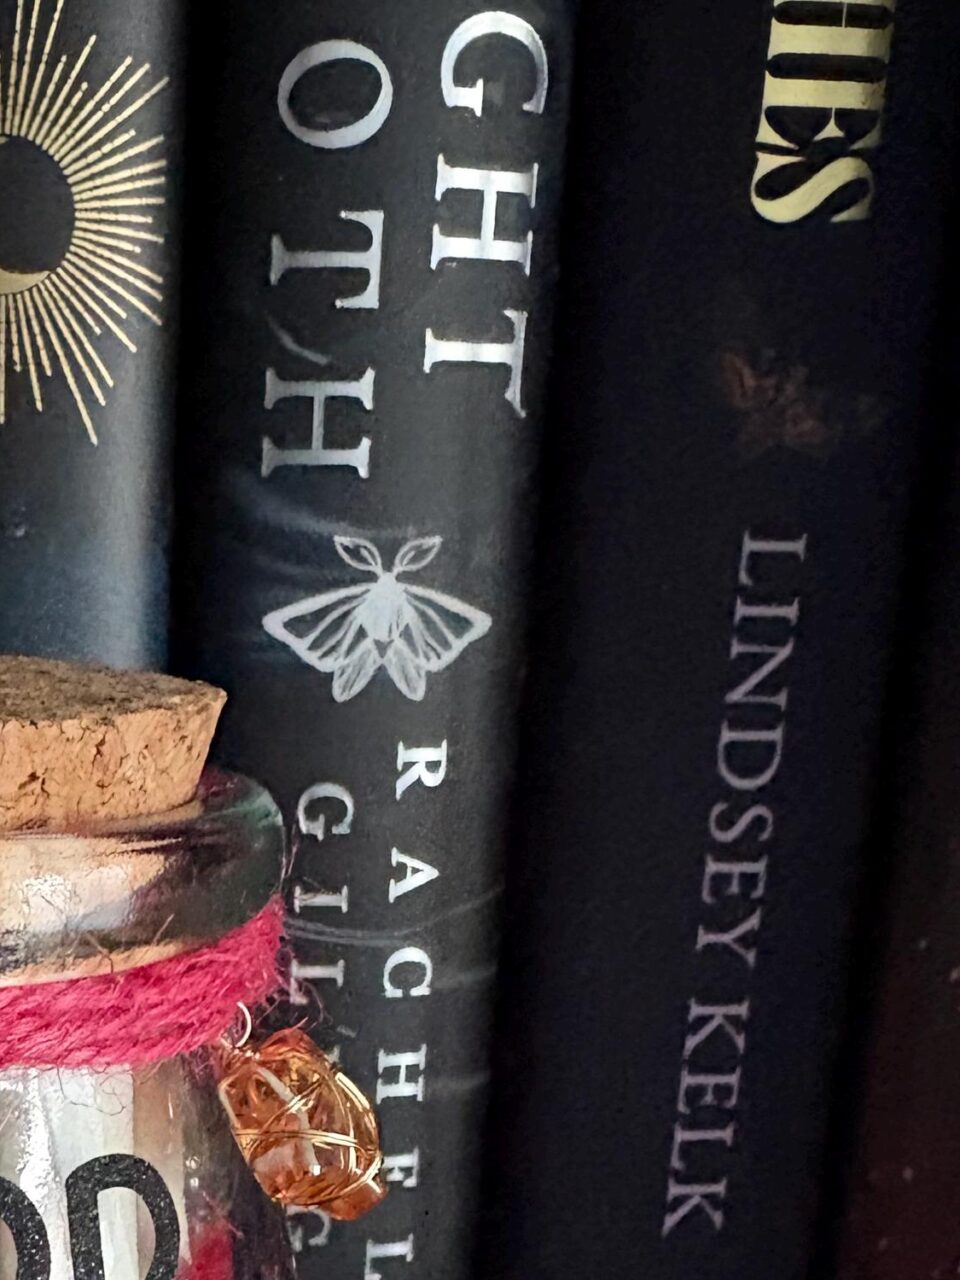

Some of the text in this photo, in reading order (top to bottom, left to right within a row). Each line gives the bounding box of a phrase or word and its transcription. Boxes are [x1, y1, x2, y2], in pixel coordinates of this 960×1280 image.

[261, 38, 393, 479] OTH
[423, 10, 549, 418] GHT
[286, 781, 355, 1252] GILG
[661, 529, 808, 1238] LINDSEY KELK
